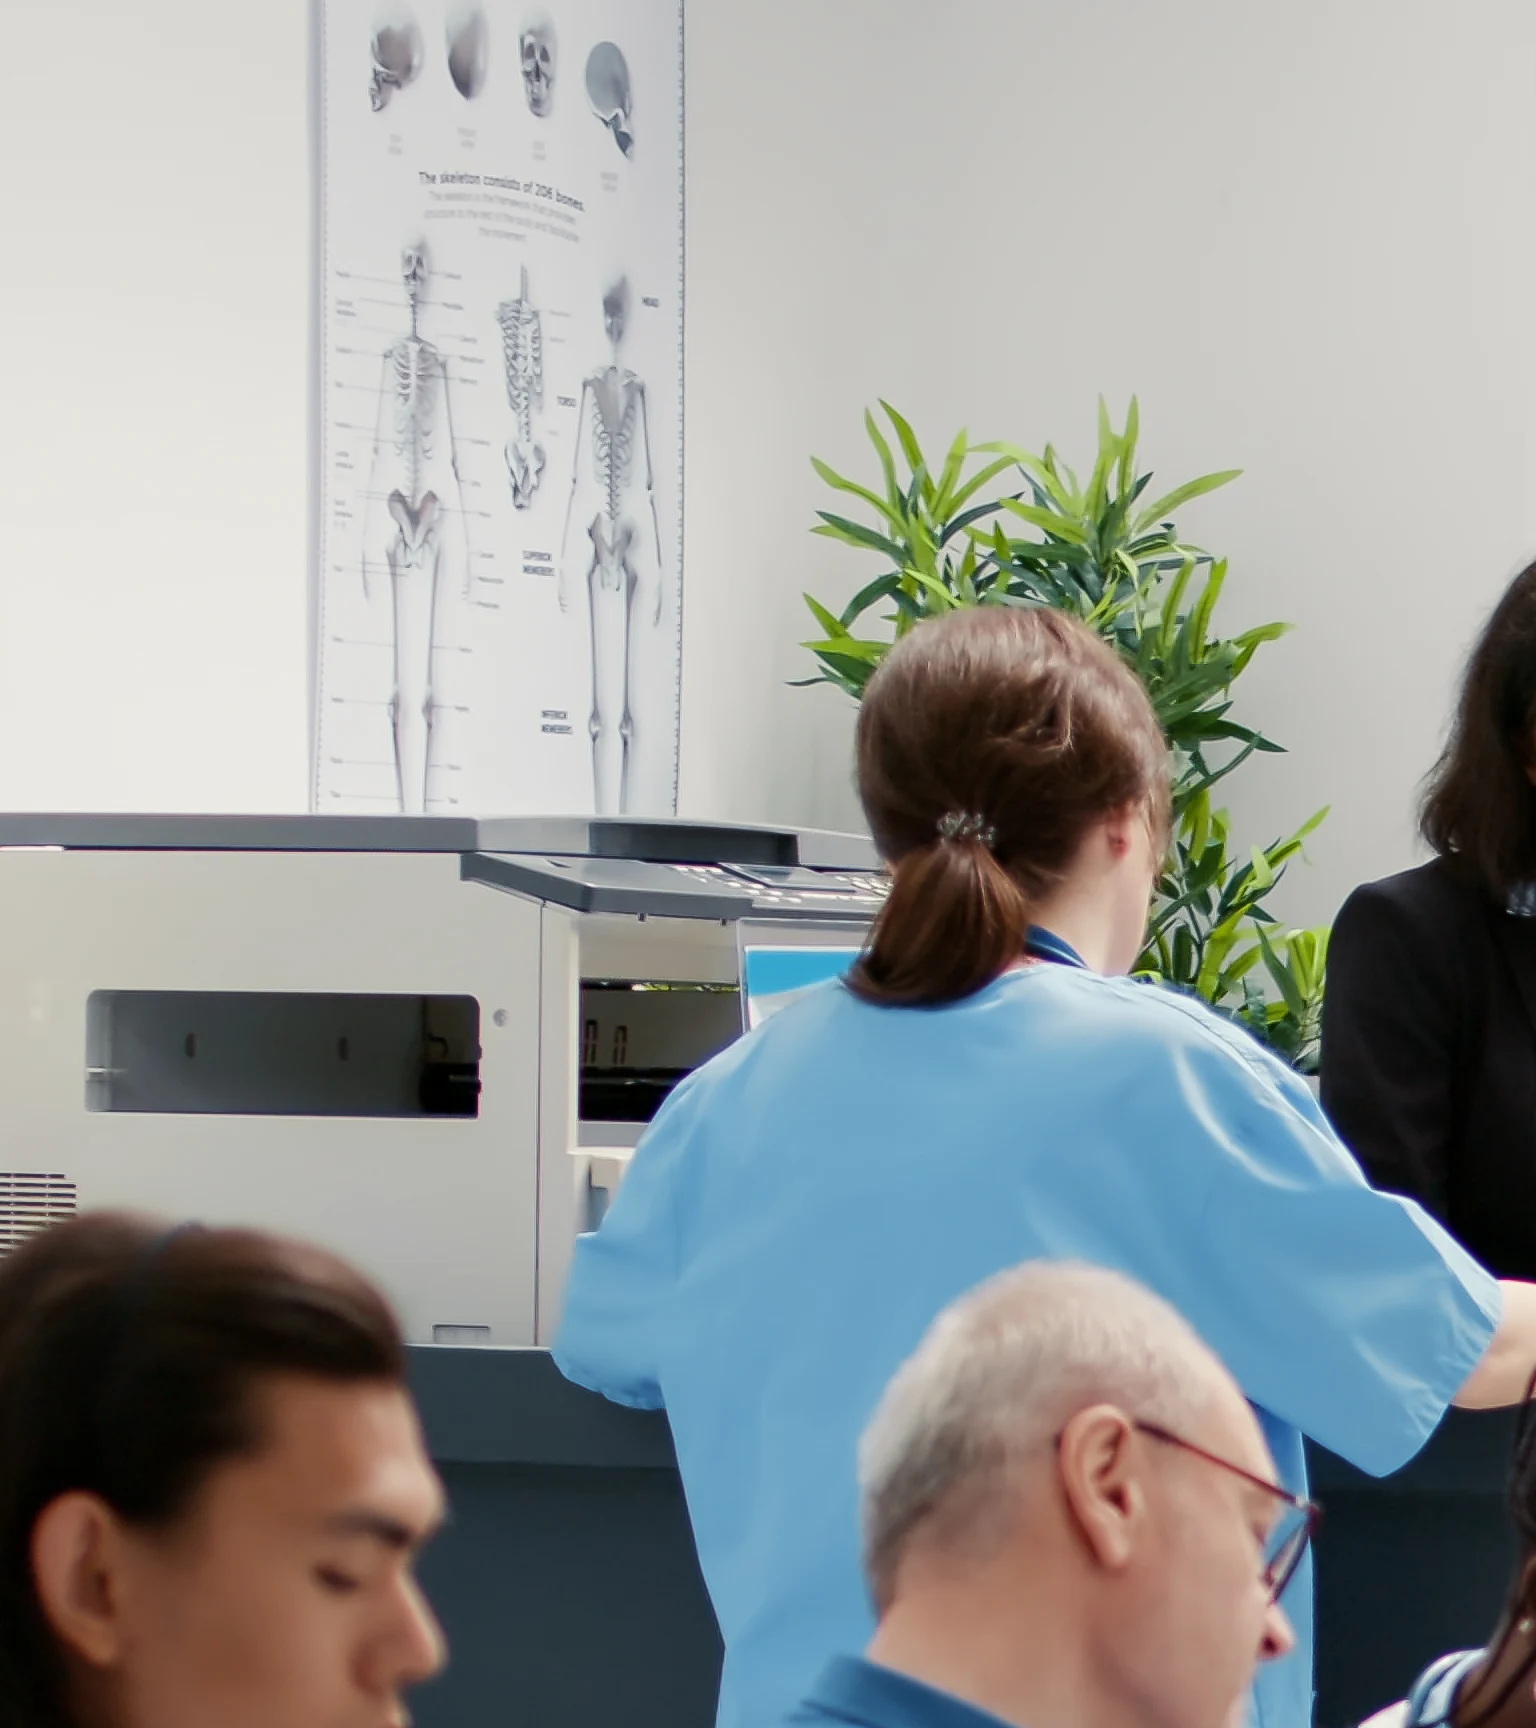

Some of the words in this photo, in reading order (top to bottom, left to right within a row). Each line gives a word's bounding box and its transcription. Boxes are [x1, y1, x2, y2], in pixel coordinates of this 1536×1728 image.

[419, 171, 436, 184] The
[440, 170, 480, 185] skeleton
[483, 175, 520, 190] consists
[523, 181, 533, 193] of
